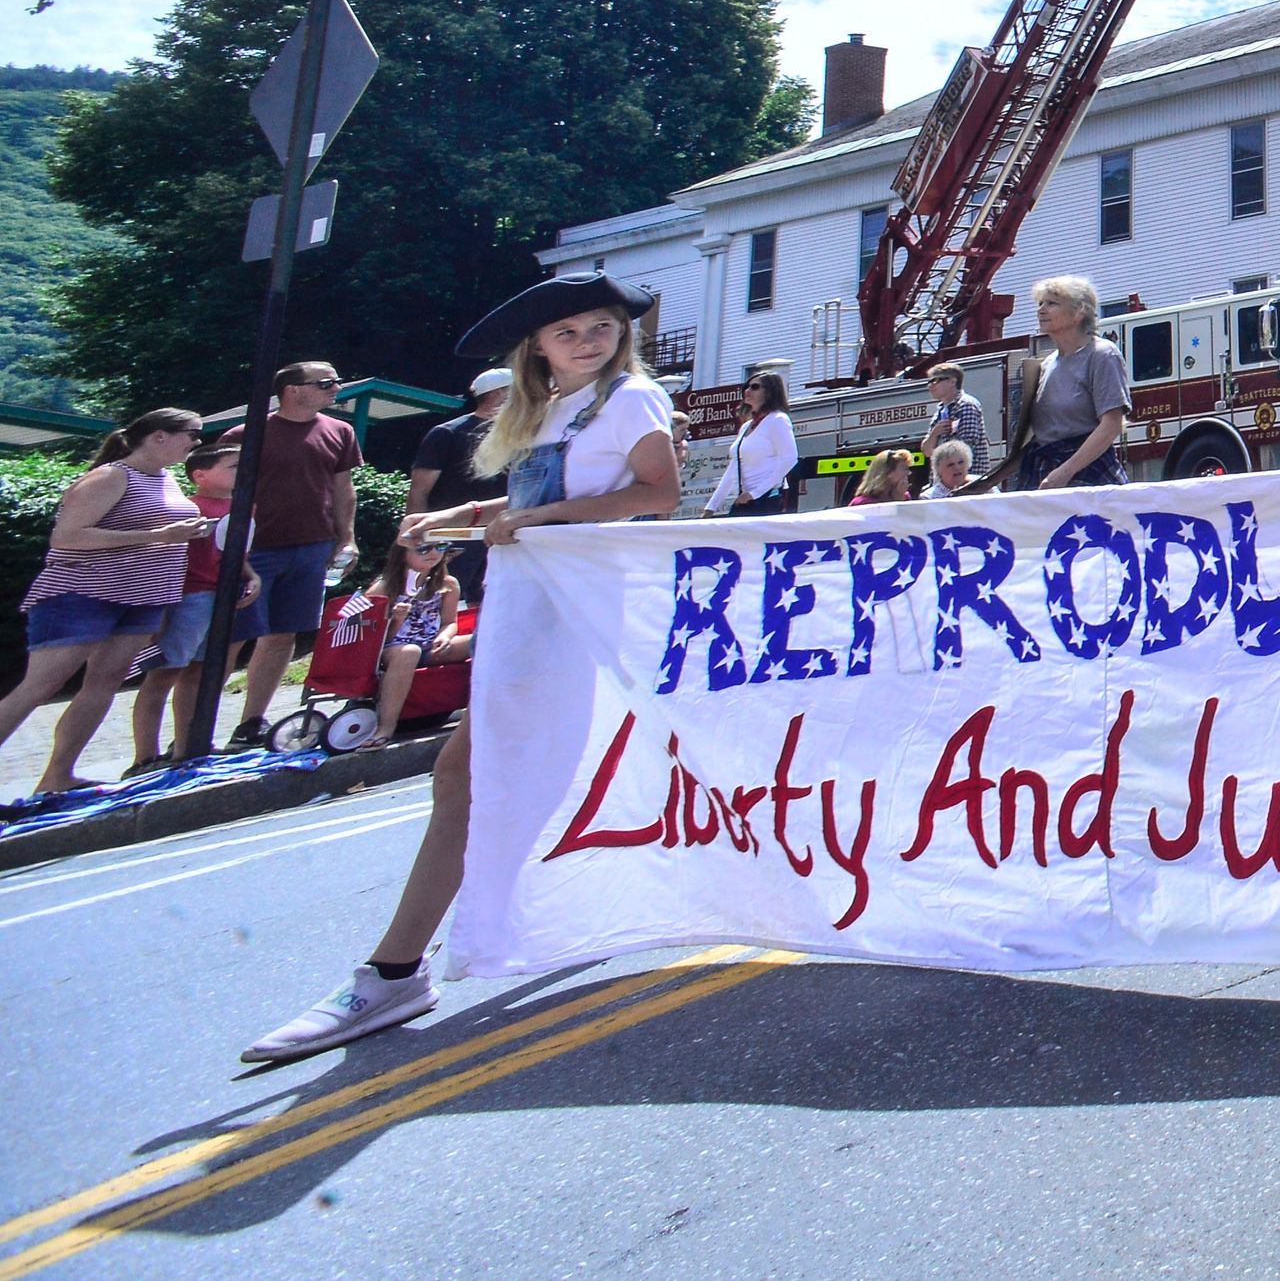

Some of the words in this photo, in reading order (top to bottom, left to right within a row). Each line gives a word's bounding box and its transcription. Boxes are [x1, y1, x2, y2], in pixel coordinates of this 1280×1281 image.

[687, 387, 743, 408] Communit
[706, 404, 733, 422] Bank
[1136, 404, 1171, 419] LADDER
[899, 690, 1134, 869] And
